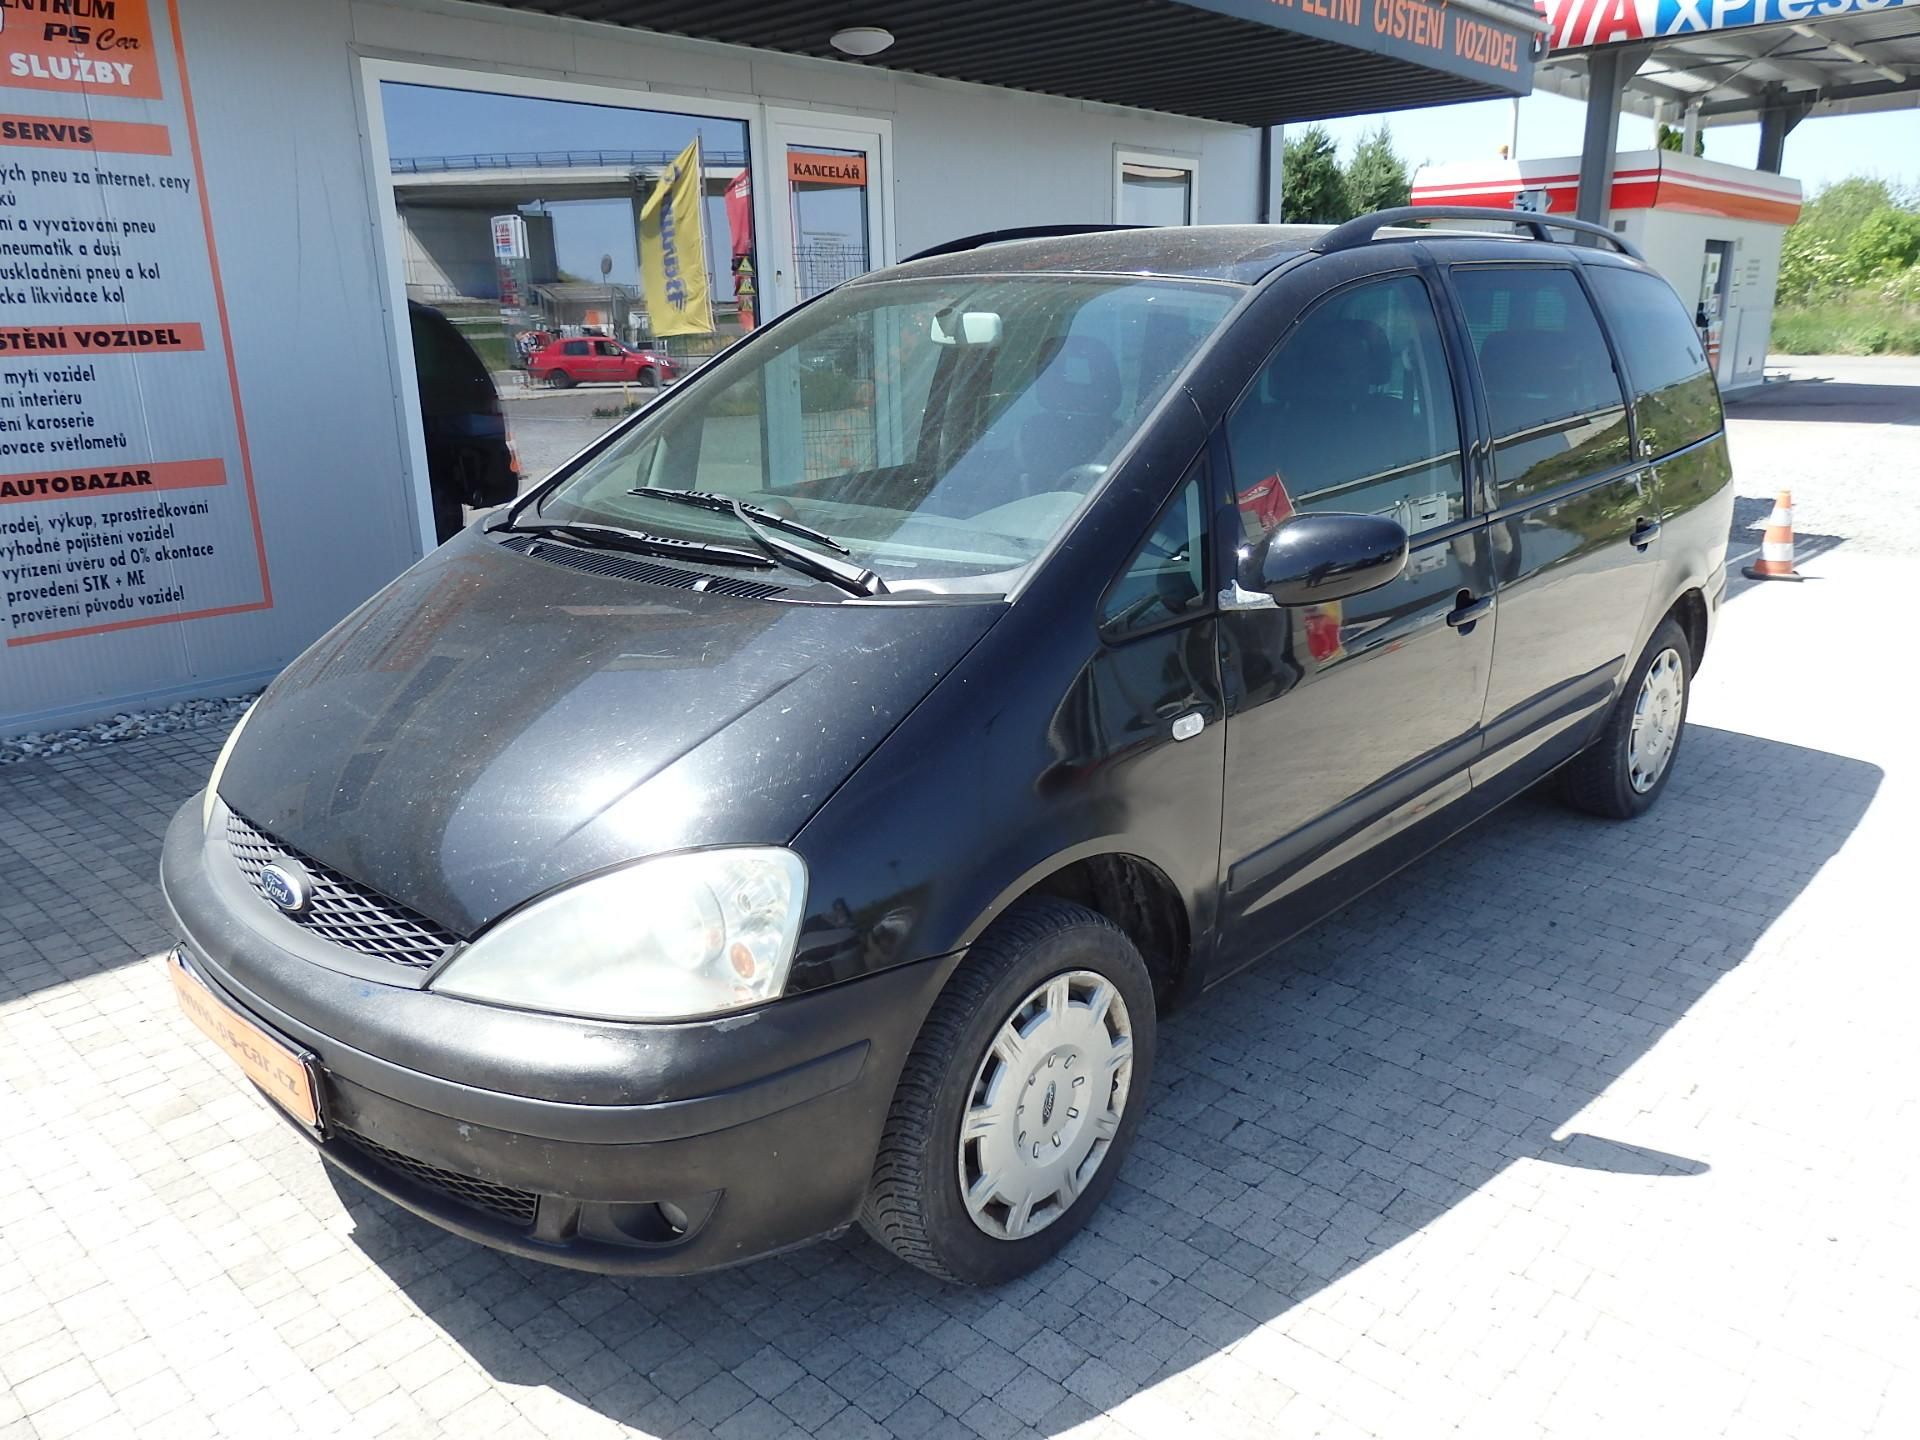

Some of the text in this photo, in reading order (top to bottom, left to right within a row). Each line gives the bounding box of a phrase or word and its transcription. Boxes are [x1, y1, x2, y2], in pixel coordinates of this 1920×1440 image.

[44, 22, 141, 51] PS Car
[1455, 17, 1518, 72] VOZIDEL
[9, 51, 134, 85] SLUŽBY
[3, 121, 93, 144] SERVIS
[32, 170, 67, 186] pneu
[73, 172, 90, 184] za
[95, 168, 155, 188] internet.
[159, 176, 191, 193] ceny
[793, 162, 860, 179] KANCELÁŘ
[18, 219, 27, 231] a
[33, 215, 118, 236] vyvažování
[123, 220, 156, 237] pneu
[0, 239, 73, 256] neumatik
[79, 244, 88, 256] a
[0, 262, 160, 284] uskladnění pneu a kol
[31, 285, 98, 304] likvidace
[102, 285, 125, 304] kol
[74, 329, 181, 348] VOZIDEL
[4, 364, 96, 388] mytí vozidel
[19, 389, 82, 408] interiéru
[25, 412, 94, 431] karoserie
[0, 432, 127, 456] ovace světlometů
[1, 470, 152, 497] AUTOBAZAR
[0, 499, 209, 535] rodej, výkup, zprostředkování
[0, 523, 175, 561] výhodné pojištění vozidel
[2, 543, 214, 584] vyřízení úvěru od 0% akontace
[7, 578, 79, 607] provedení
[83, 574, 110, 593] STK
[127, 569, 146, 587] ME
[11, 601, 81, 628] prověření
[85, 592, 134, 617] původu
[138, 585, 185, 606] vozidel
[265, 873, 290, 903] Ford
